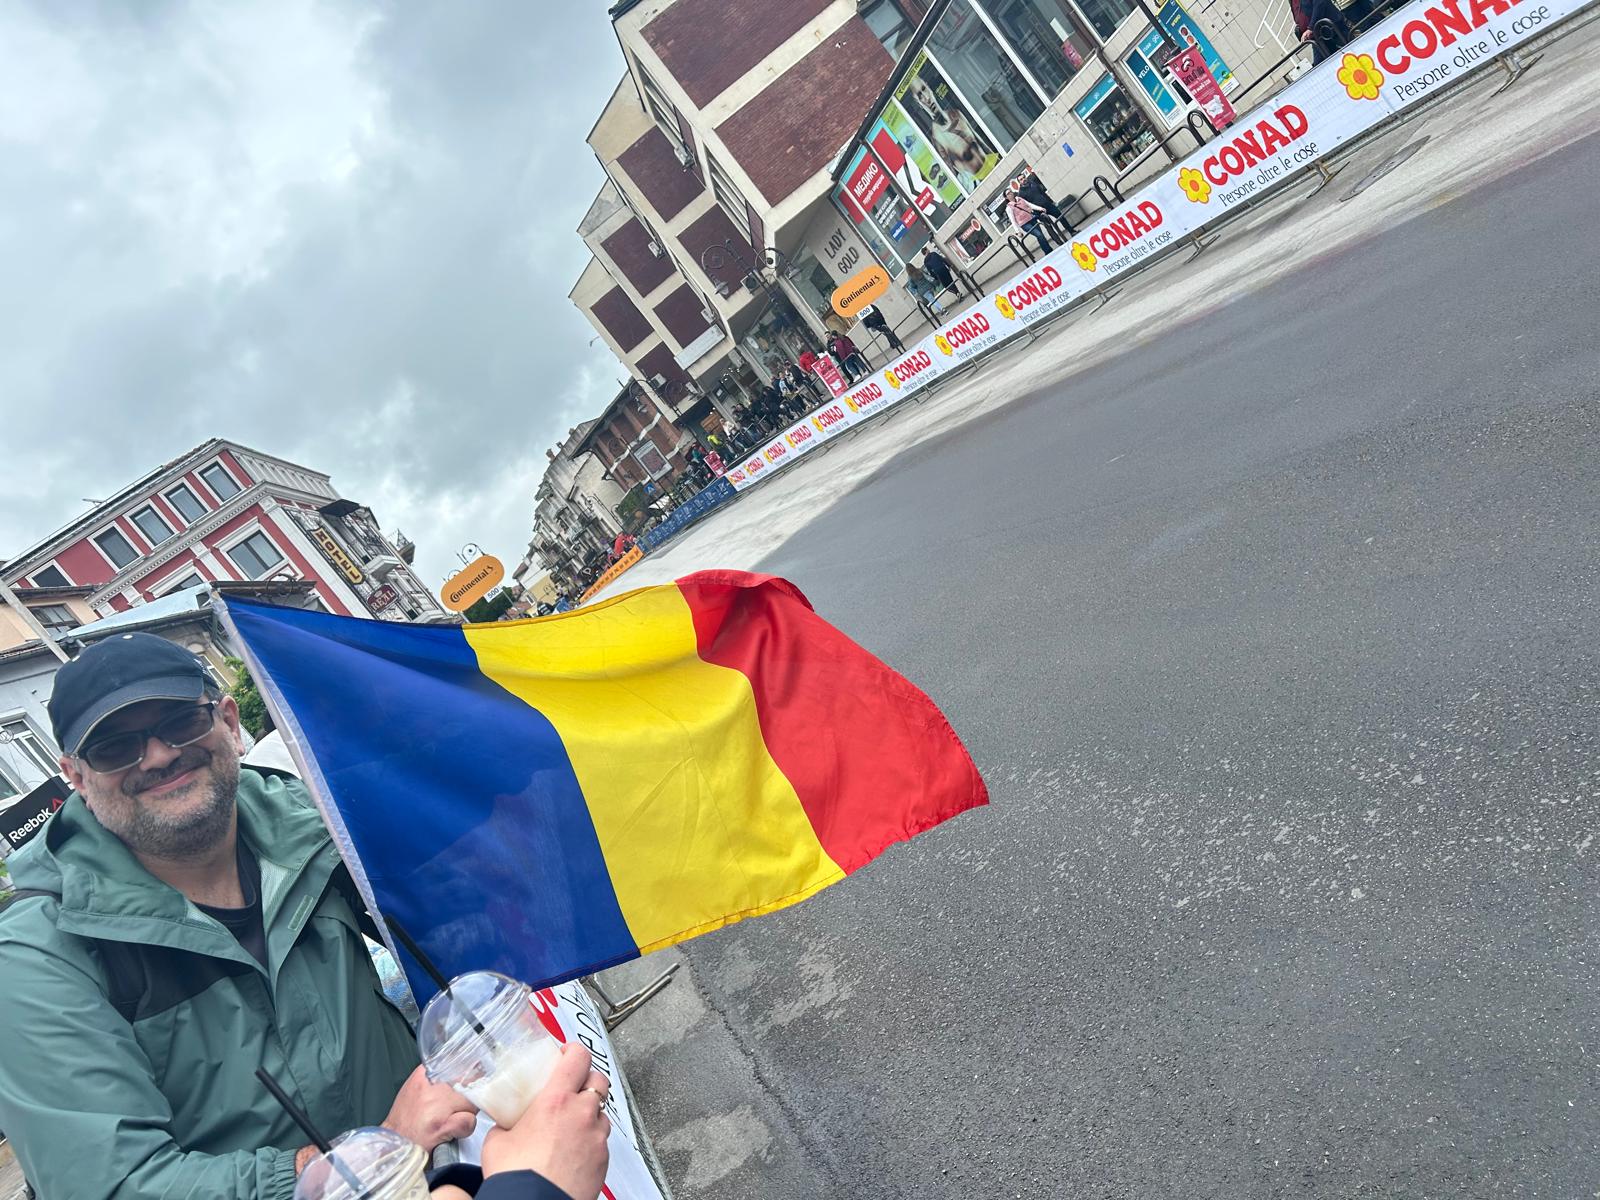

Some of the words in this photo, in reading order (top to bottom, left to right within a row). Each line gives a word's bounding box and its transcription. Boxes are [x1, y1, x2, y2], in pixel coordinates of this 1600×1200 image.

[1393, 63, 1450, 102] Persone
[1453, 40, 1490, 67] oltre
[1488, 28, 1509, 46] le
[1512, 5, 1551, 34] cose
[1204, 104, 1308, 185] CONAD
[853, 162, 879, 197] МЕДИКО
[1218, 178, 1257, 207] Persone
[1257, 165, 1281, 185] oltre
[1278, 156, 1292, 171] le
[1294, 141, 1318, 163] cose
[824, 228, 847, 259] LADY
[1089, 201, 1162, 258] CONAD
[837, 246, 860, 275] GOLD
[1103, 255, 1132, 275] Persone
[1155, 230, 1173, 245] cose
[1007, 265, 1062, 310] CONAD
[946, 312, 990, 348] CONAD
[894, 350, 932, 382] CONAD
[852, 382, 883, 407] CONAD
[818, 405, 844, 428] CONAD
[315, 531, 360, 580] HOTEL
[370, 588, 396, 611] REAL
[487, 588, 500, 599] 500
[8, 807, 53, 843] Reebok
